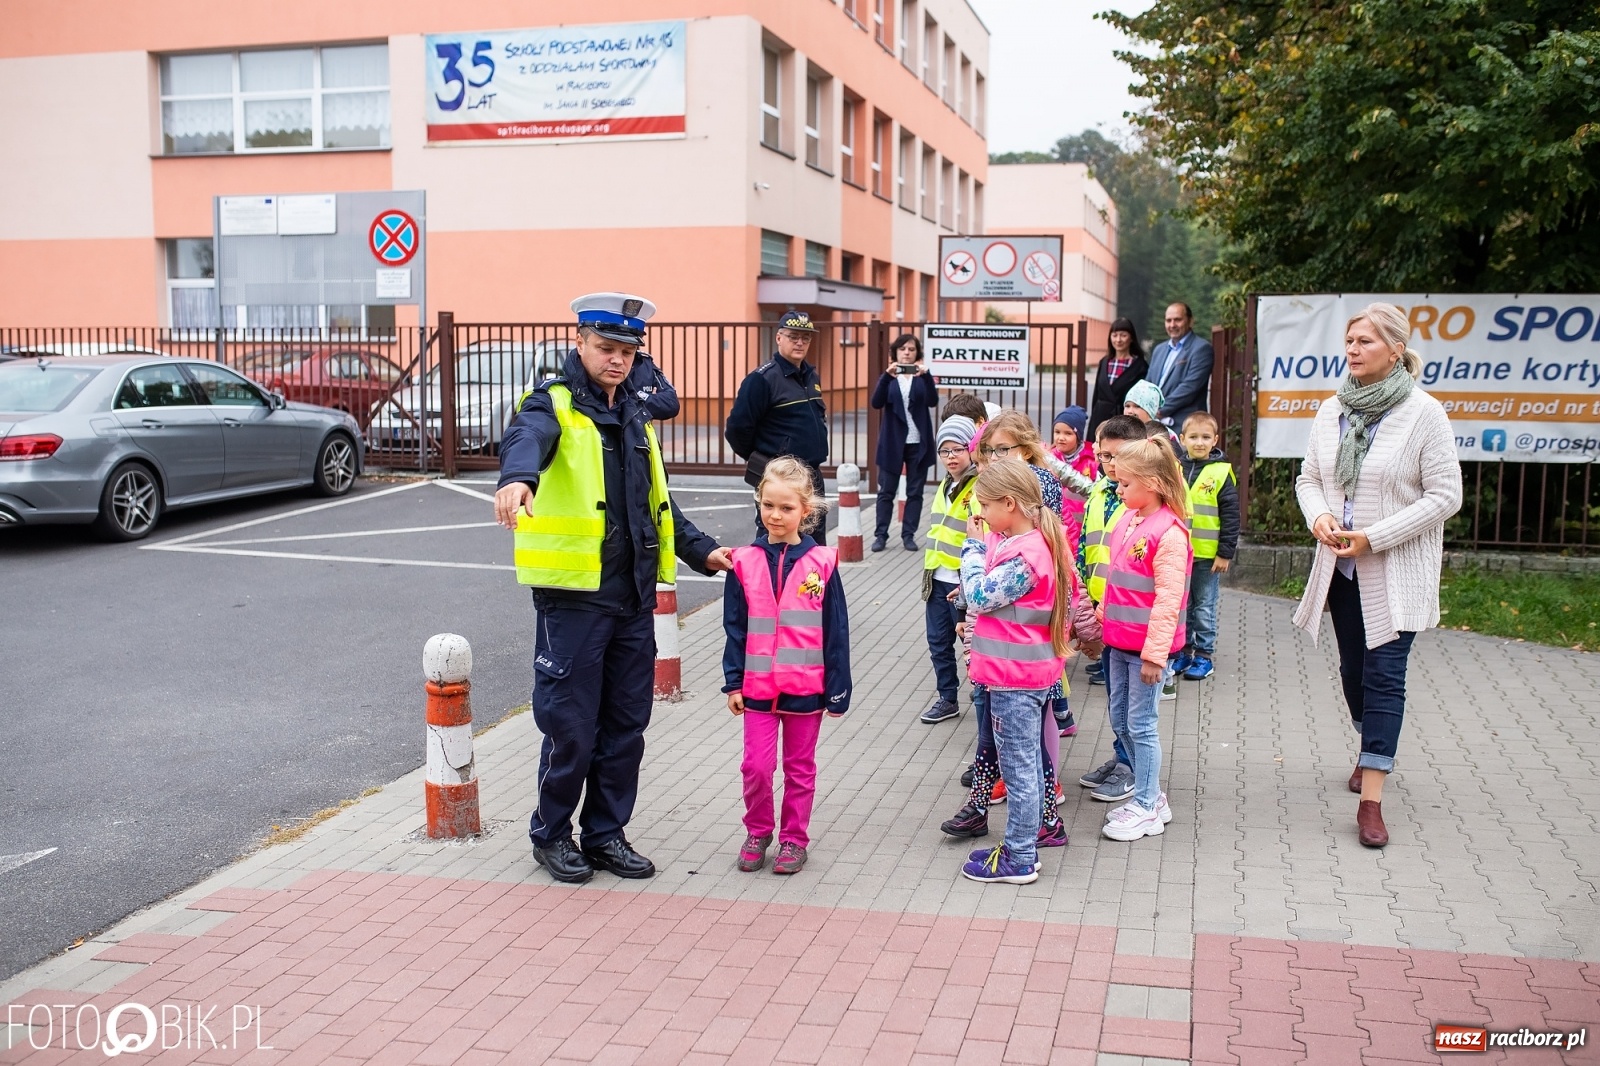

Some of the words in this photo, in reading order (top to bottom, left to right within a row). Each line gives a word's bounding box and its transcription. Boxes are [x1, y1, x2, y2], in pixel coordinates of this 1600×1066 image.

[435, 41, 496, 112] 35
[467, 93, 497, 111] LAT
[497, 123, 610, 137] sp15raciborz.edupage.org
[1397, 305, 1476, 342] RO
[932, 329, 966, 337] OBIEKT
[967, 330, 1022, 339] CHRONIONY
[932, 348, 1020, 361] PARTNER
[982, 365, 1020, 373] security
[1271, 355, 1348, 380] NOW
[1421, 356, 1512, 385] glane
[1268, 396, 1322, 414] Zapra
[1441, 398, 1513, 417] erwacji
[1517, 399, 1560, 417] pod
[1564, 401, 1588, 415] nr
